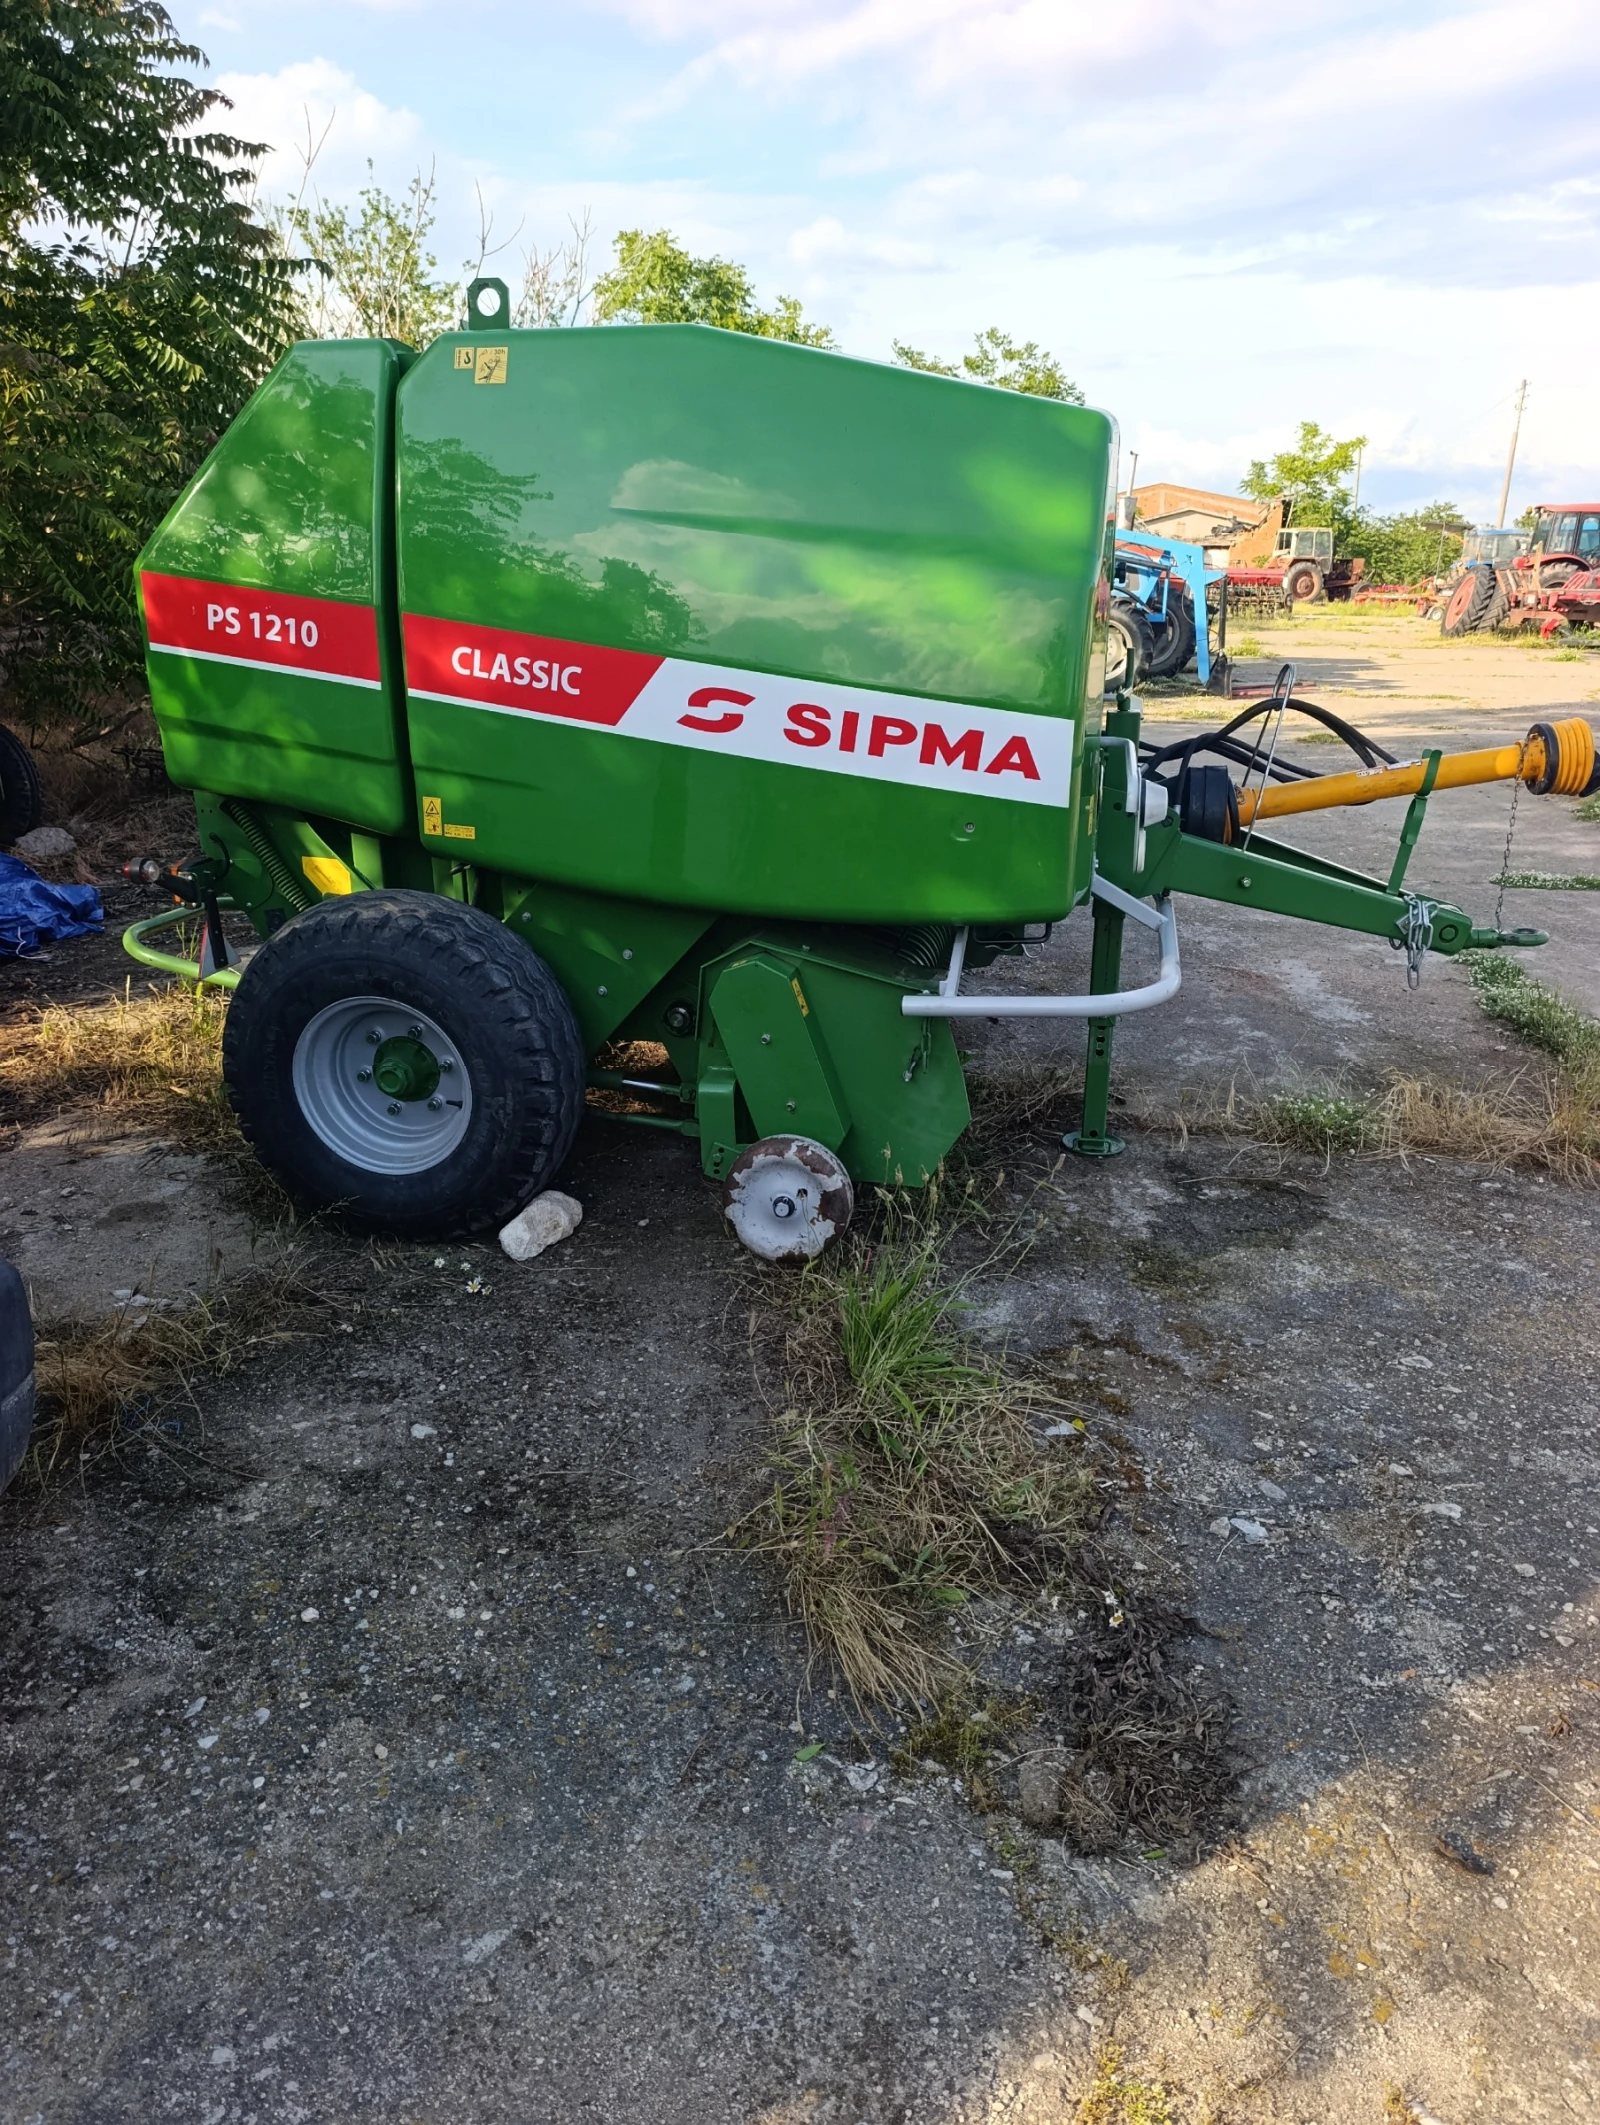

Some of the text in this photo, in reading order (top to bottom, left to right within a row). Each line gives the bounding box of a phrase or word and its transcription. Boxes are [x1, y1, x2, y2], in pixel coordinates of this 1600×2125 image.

[207, 603, 318, 648] PS 1210
[451, 646, 582, 695] CLASSIC
[783, 703, 1041, 780] SIPMA
